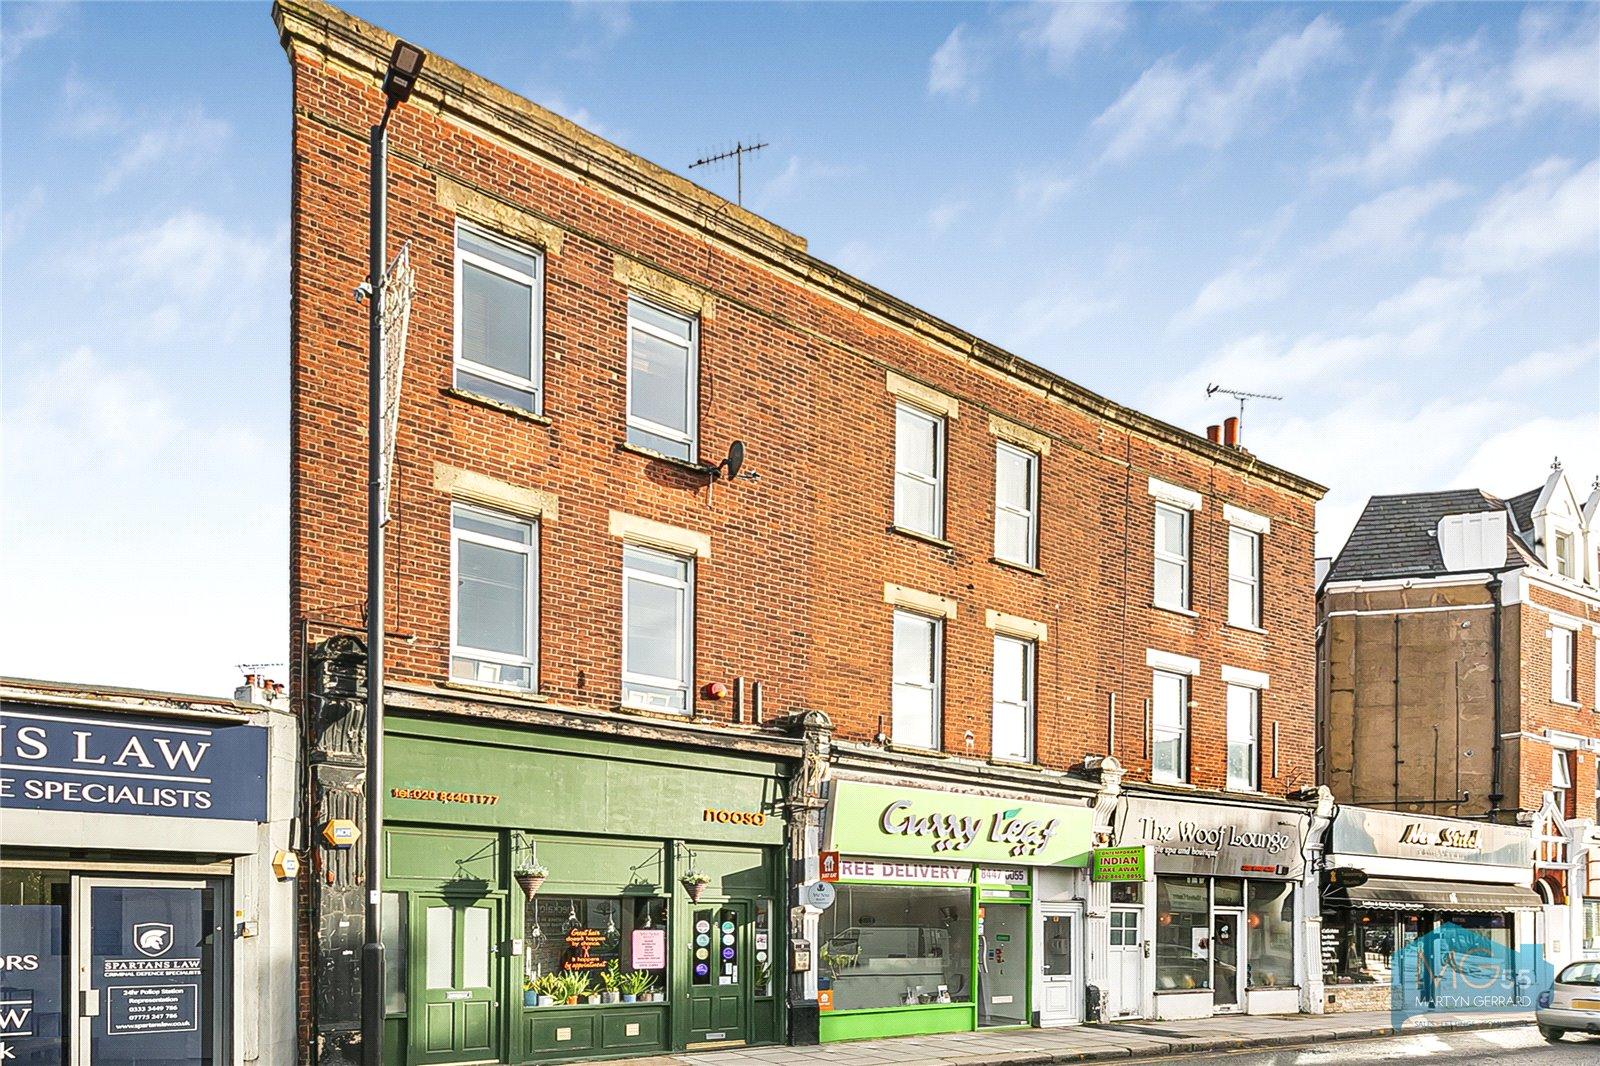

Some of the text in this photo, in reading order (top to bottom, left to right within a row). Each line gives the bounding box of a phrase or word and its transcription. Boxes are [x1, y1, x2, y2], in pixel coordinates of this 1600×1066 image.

[0, 725, 211, 772] S LAW
[24, 779, 212, 809] SPECIALISTS
[879, 800, 1061, 857] Curry Leaf
[1138, 817, 1290, 854] The Woof Lounge
[840, 860, 961, 879] REE DELIVERY
[1100, 857, 1139, 865] INDIAN
[104, 961, 171, 970] SPARTANS
[128, 997, 179, 1005] Representation
